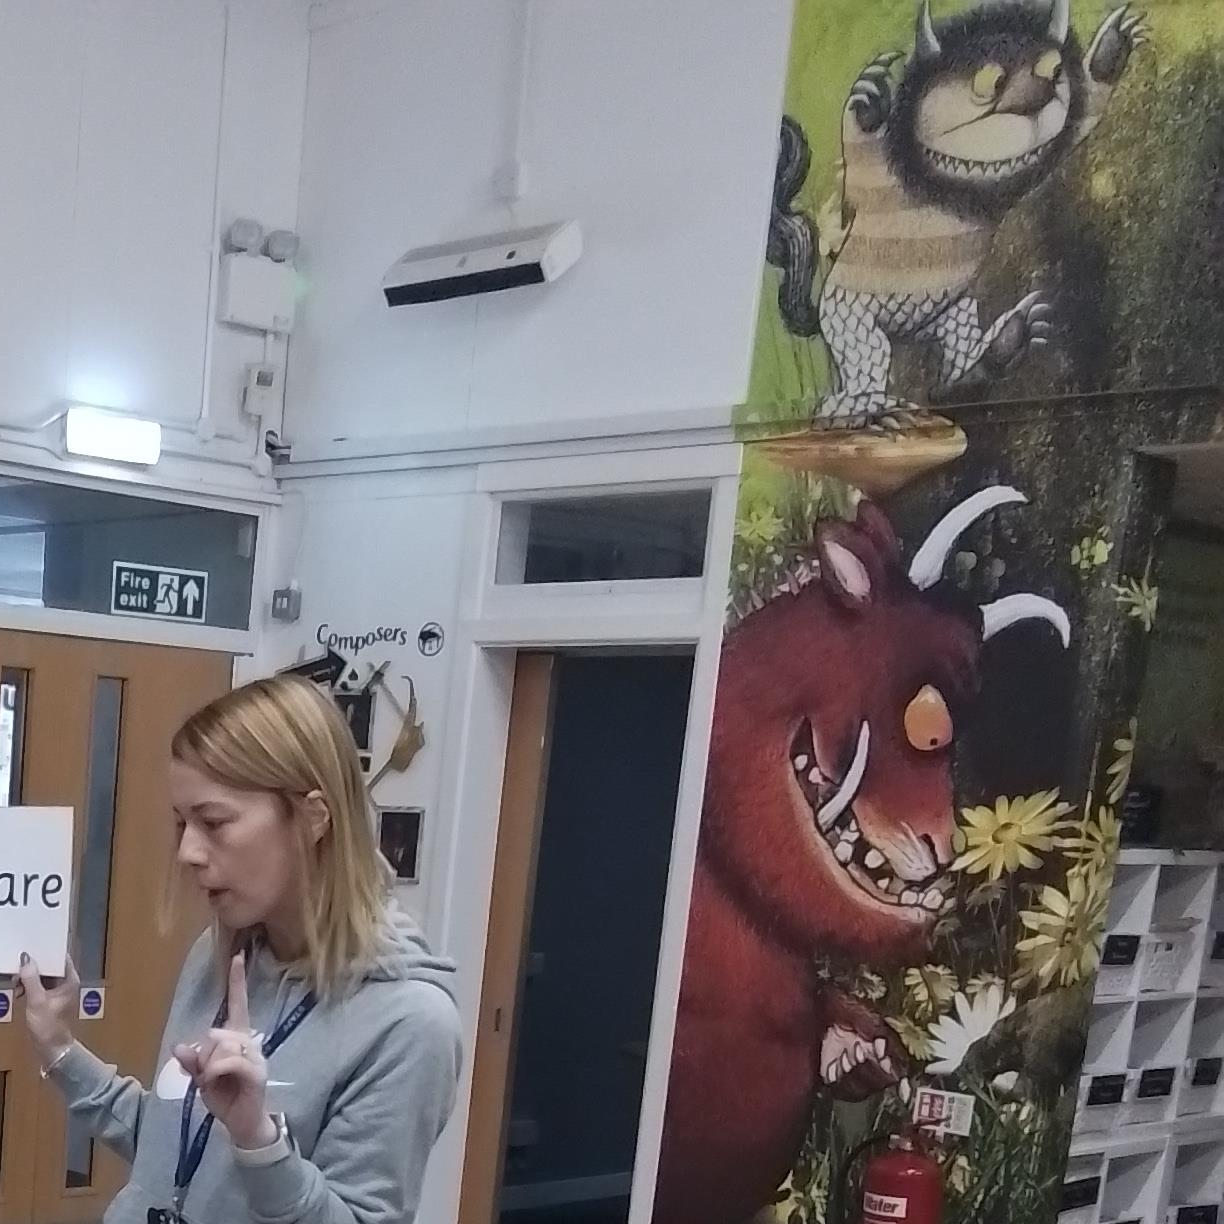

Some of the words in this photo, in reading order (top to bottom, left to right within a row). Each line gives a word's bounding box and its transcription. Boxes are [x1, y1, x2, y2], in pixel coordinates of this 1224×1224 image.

[121, 571, 150, 590] Fire
[119, 592, 148, 608] exit
[316, 624, 408, 656] Composers
